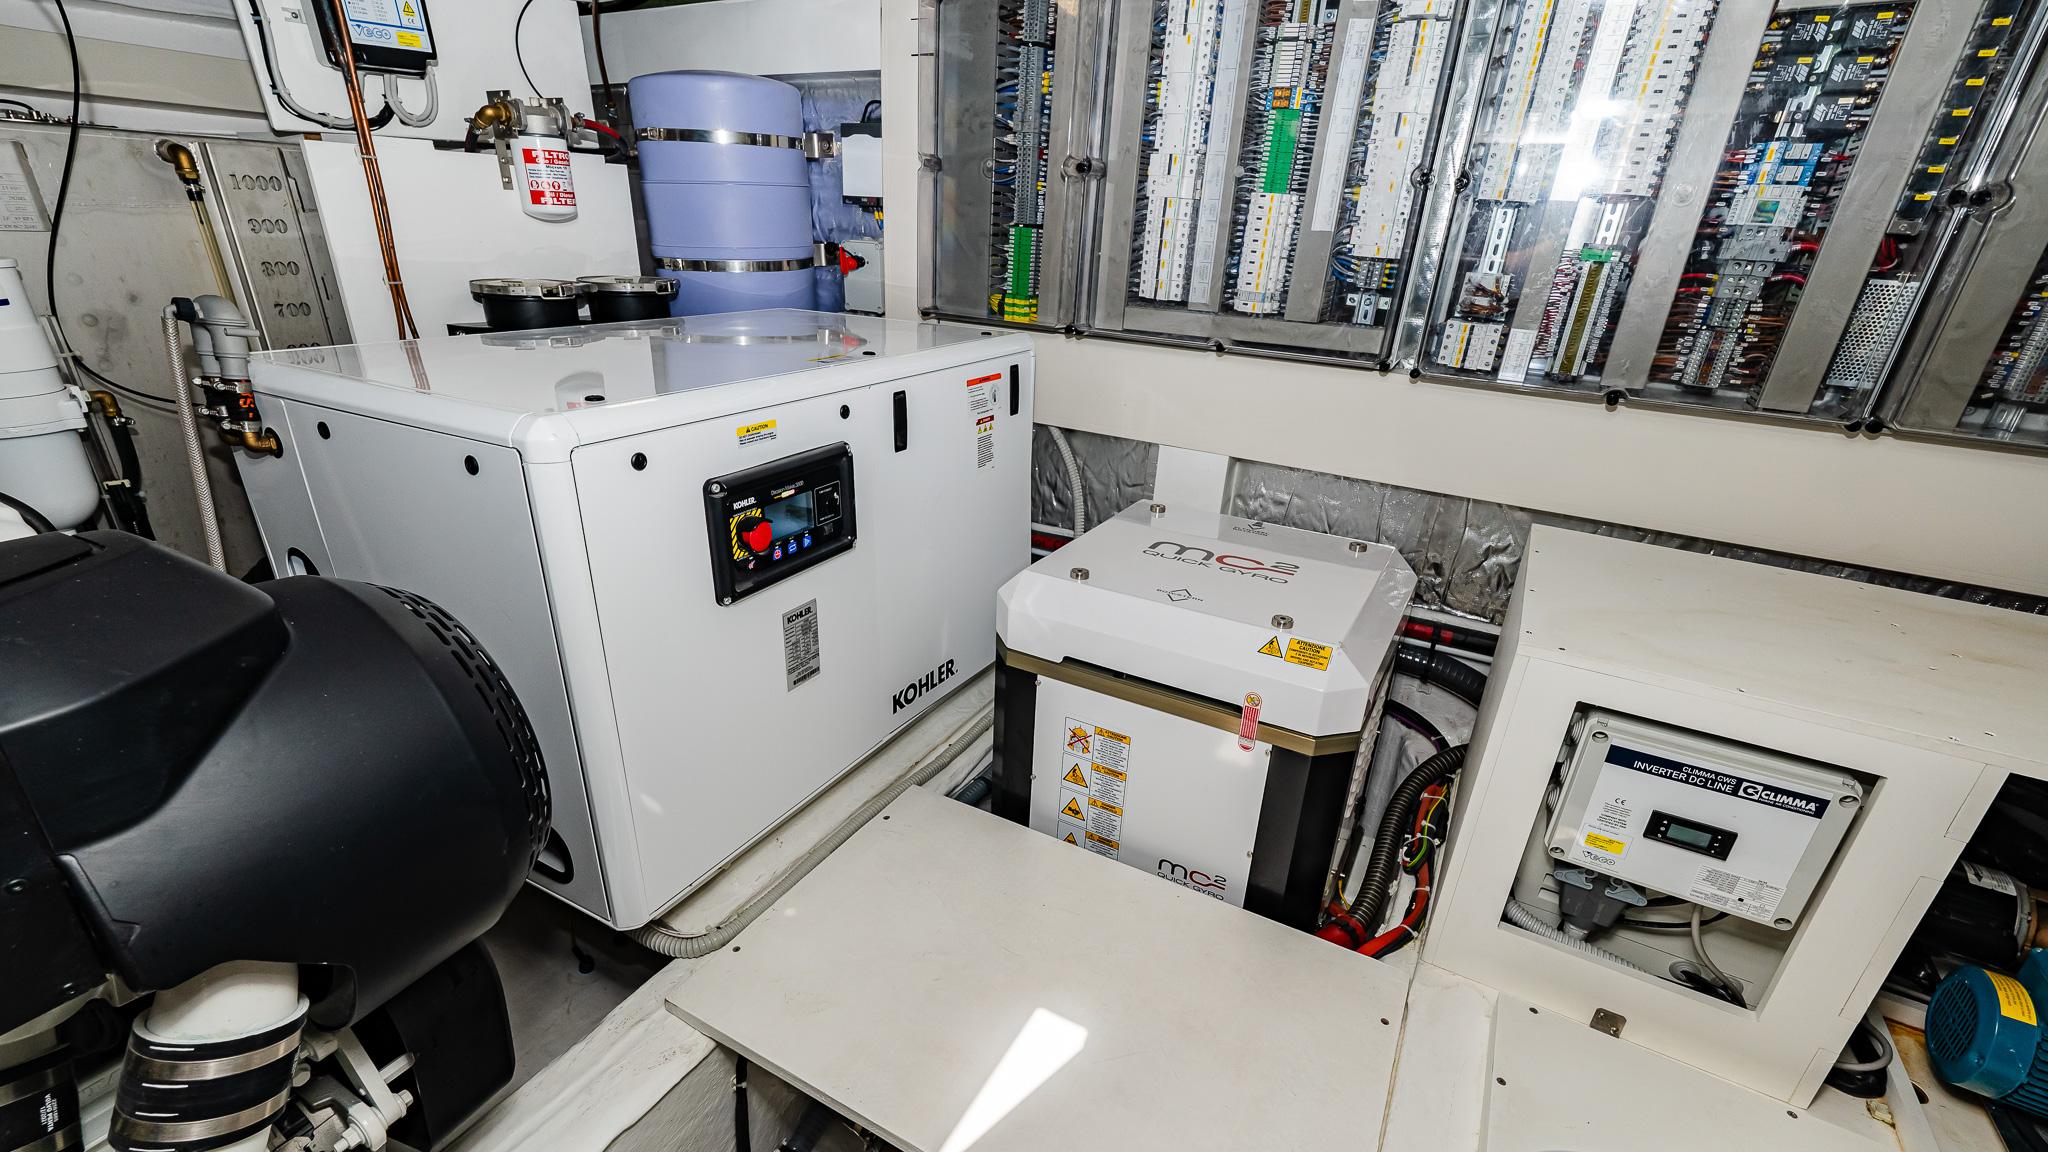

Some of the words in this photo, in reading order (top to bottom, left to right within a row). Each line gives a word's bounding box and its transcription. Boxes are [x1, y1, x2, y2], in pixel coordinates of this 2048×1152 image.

[229, 174, 282, 192] 1000
[248, 218, 288, 234] 900
[261, 261, 300, 276] 800
[274, 302, 312, 318] 700
[1142, 549, 1214, 569] QUICK
[1218, 565, 1289, 584] GYRO
[1633, 760, 1687, 781] INVERTER
[1688, 775, 1705, 786] DC
[1706, 780, 1734, 793] LINE
[1682, 766, 1716, 780] CLIMMA
[1717, 775, 1737, 785] CWS
[1157, 872, 1190, 888] QUICK
[1193, 885, 1224, 901] GYRO
[44, 1093, 52, 1112] VOLVO
[46, 1112, 54, 1133] PENTA
